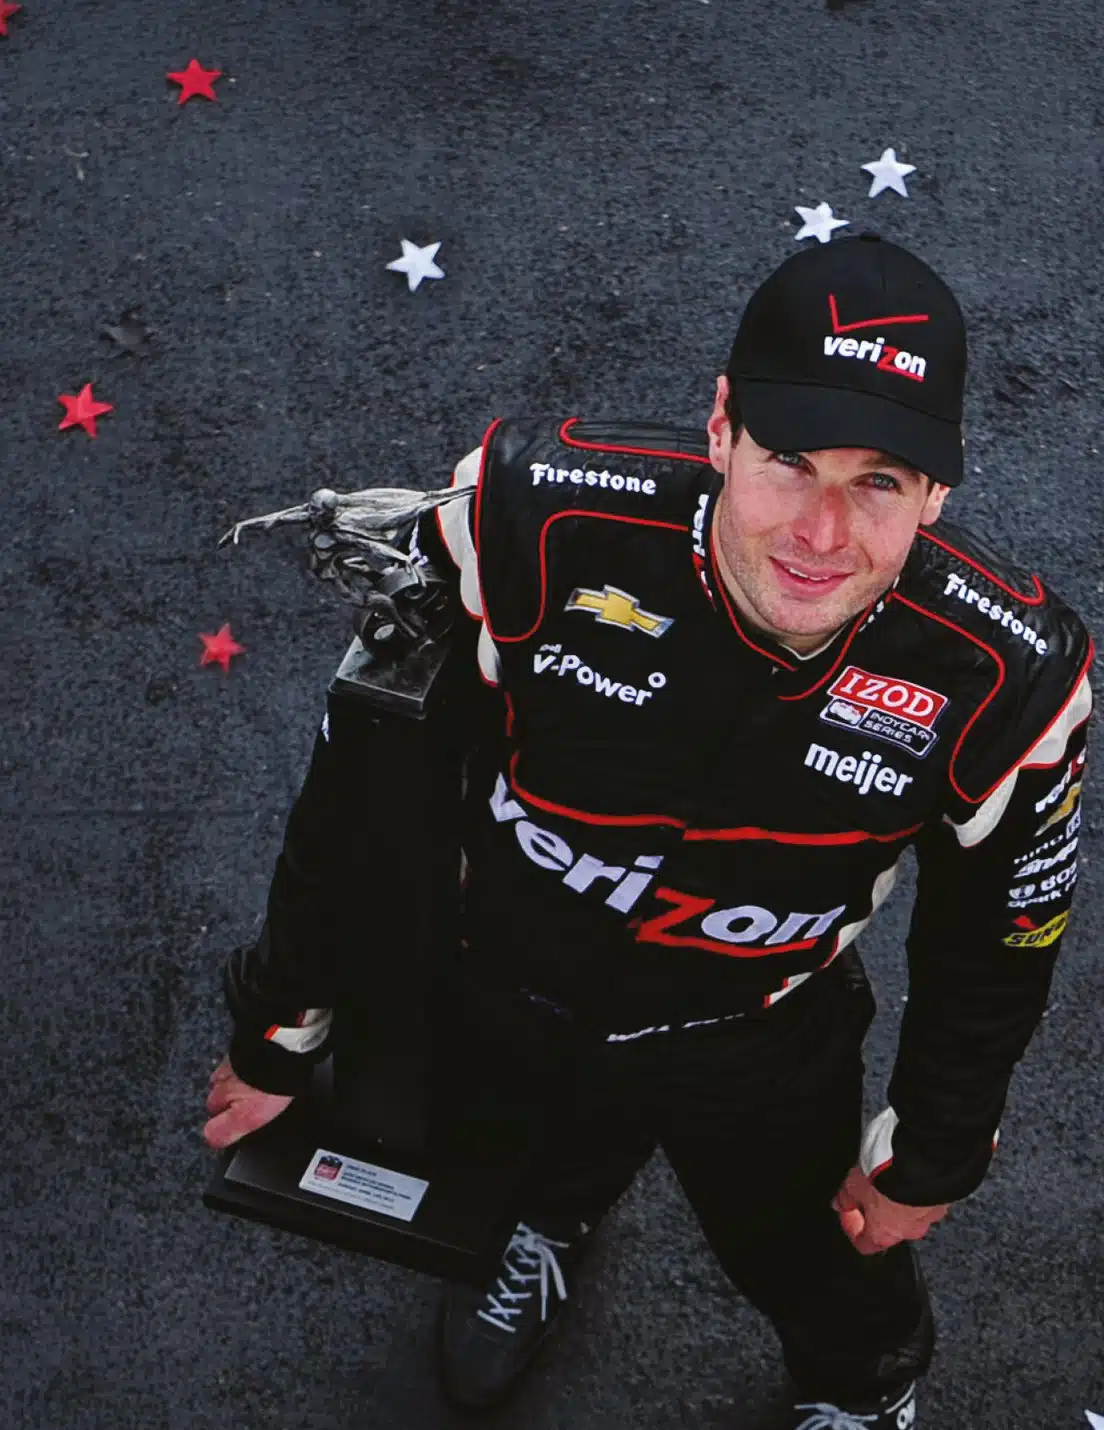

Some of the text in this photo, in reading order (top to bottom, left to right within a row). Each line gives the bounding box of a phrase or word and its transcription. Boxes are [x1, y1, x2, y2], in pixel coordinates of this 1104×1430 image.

[823, 336, 927, 382] verizon
[529, 462, 657, 496] Firestone
[943, 572, 1048, 655] Firestone
[840, 672, 934, 717] IZOD
[863, 721, 913, 744] SERIES
[803, 743, 914, 796] meijer
[489, 771, 847, 958] verizon
